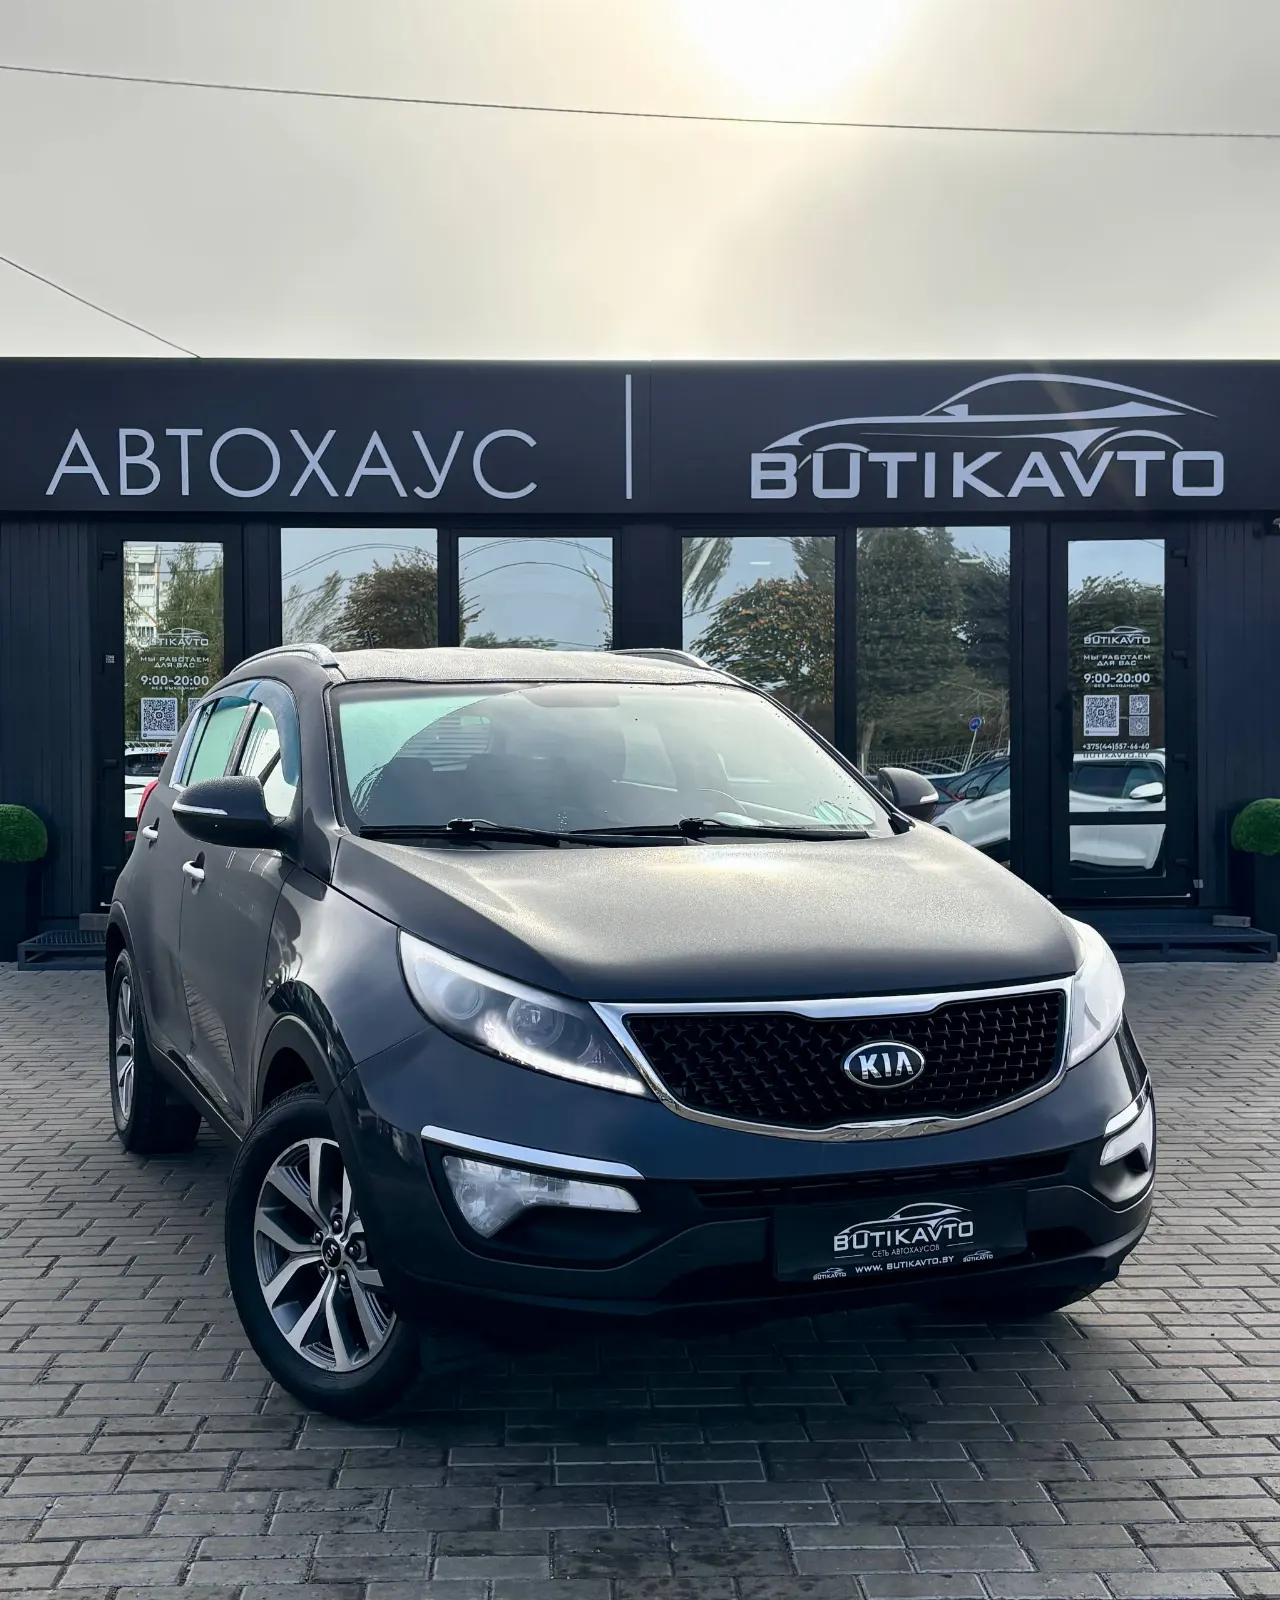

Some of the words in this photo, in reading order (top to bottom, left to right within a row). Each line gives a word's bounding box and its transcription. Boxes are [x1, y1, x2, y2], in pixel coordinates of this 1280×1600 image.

[45, 427, 538, 499] АВТОХАУС
[750, 450, 1225, 499] BUTIKAVTO
[1083, 636, 1151, 645] BUTIKAVTO
[140, 675, 209, 686] 9:00-20:00
[1083, 672, 1150, 684] 9:00-20:00
[858, 1051, 914, 1080] KIA
[833, 1221, 974, 1252] BUTIKAVTO
[871, 1249, 890, 1258] СЕТЬ
[891, 1244, 940, 1256] АВТОХАУСОВ
[855, 1264, 883, 1274] WWW.
[886, 1255, 955, 1270] BUTIKAVTO.BY
